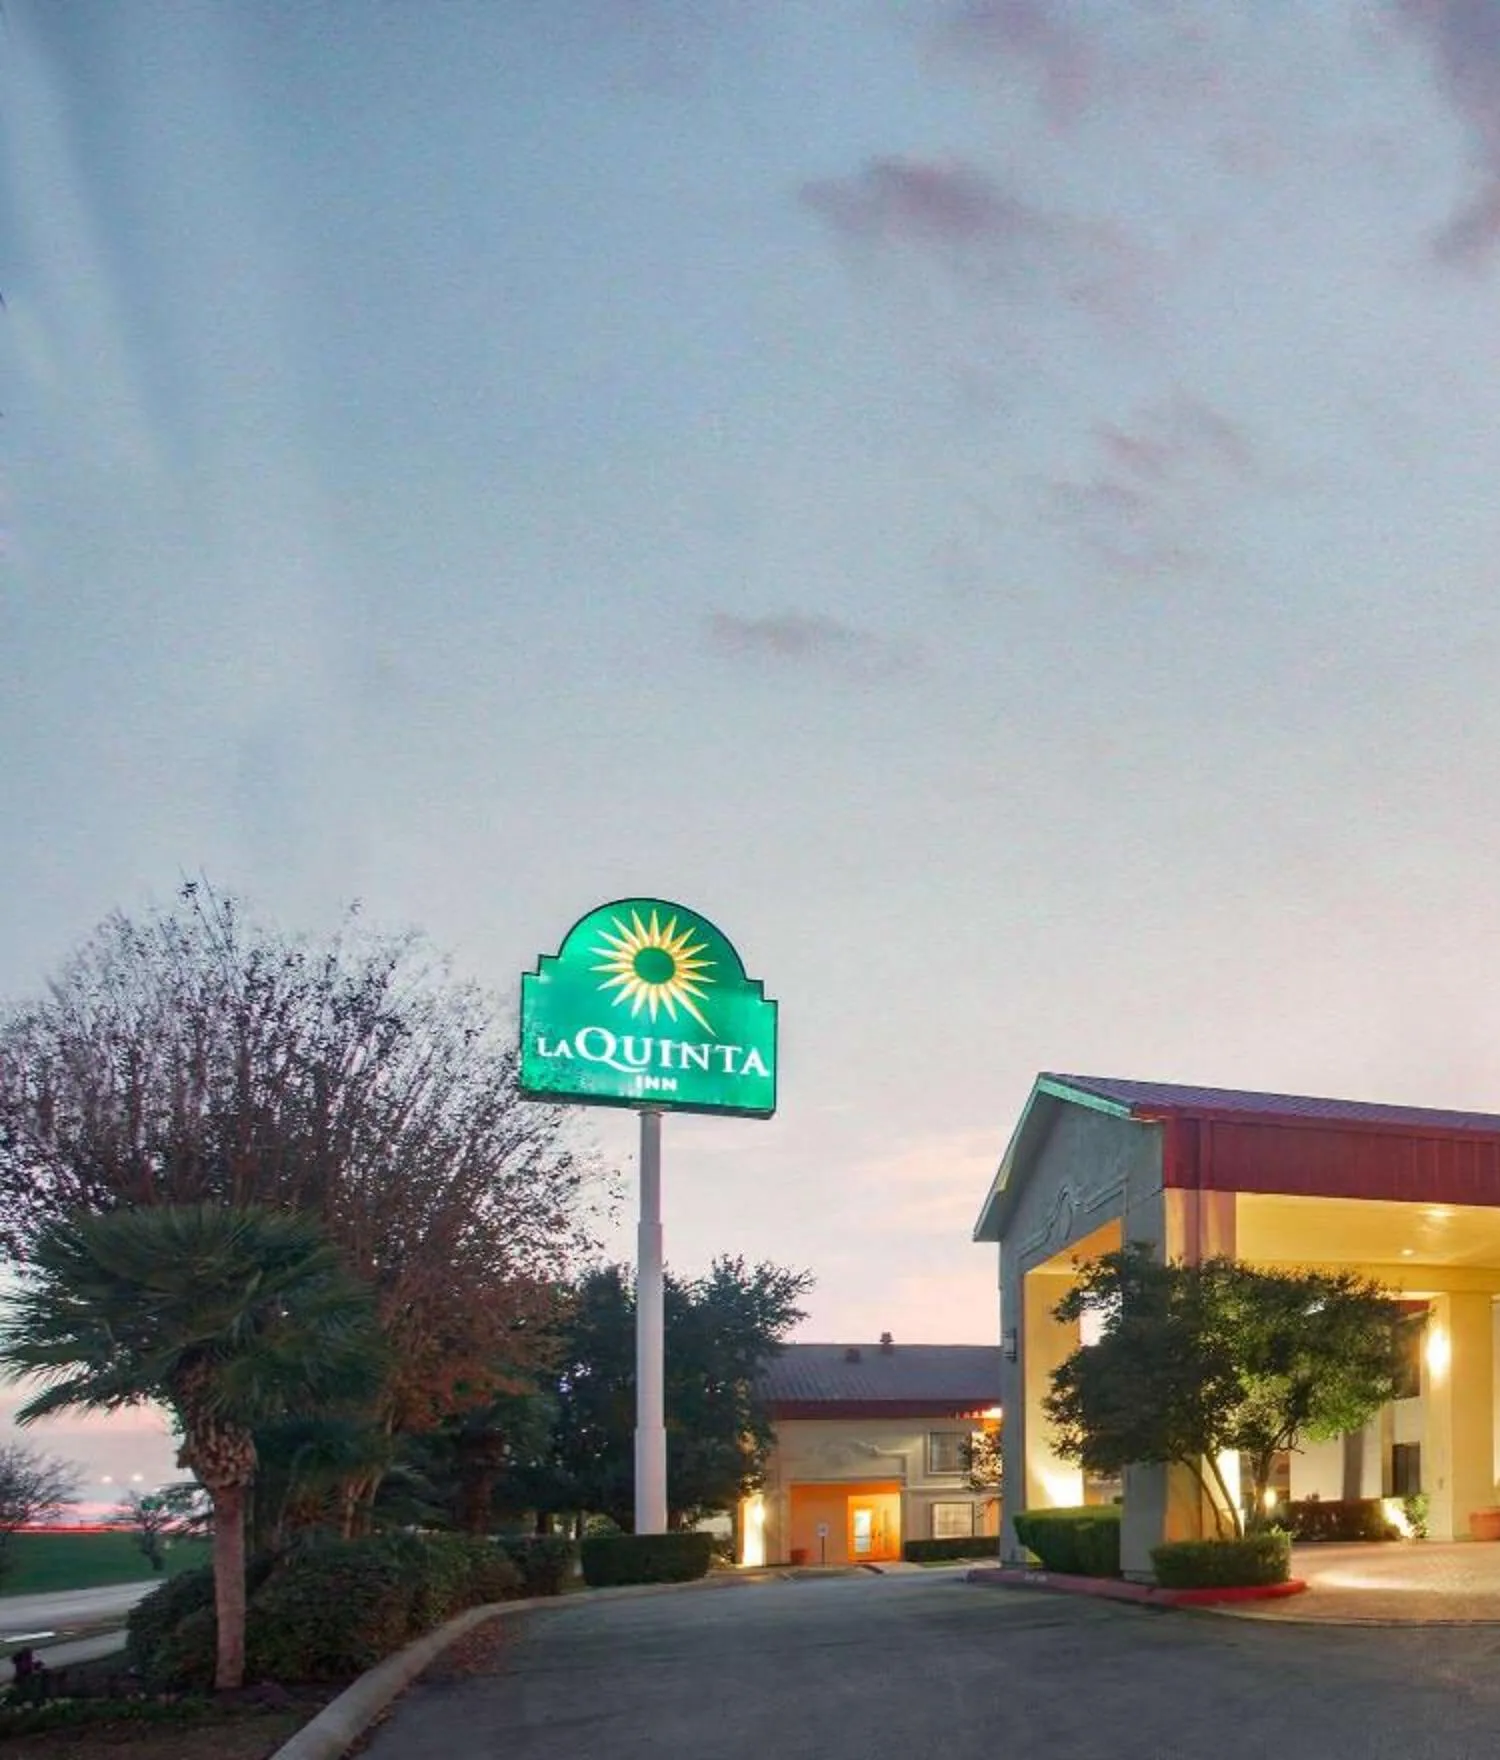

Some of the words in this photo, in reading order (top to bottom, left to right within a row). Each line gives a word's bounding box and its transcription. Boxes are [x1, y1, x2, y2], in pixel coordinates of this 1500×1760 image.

[537, 1036, 574, 1059] LA
[574, 1026, 770, 1077] QUINTA
[634, 1075, 678, 1091] INN
